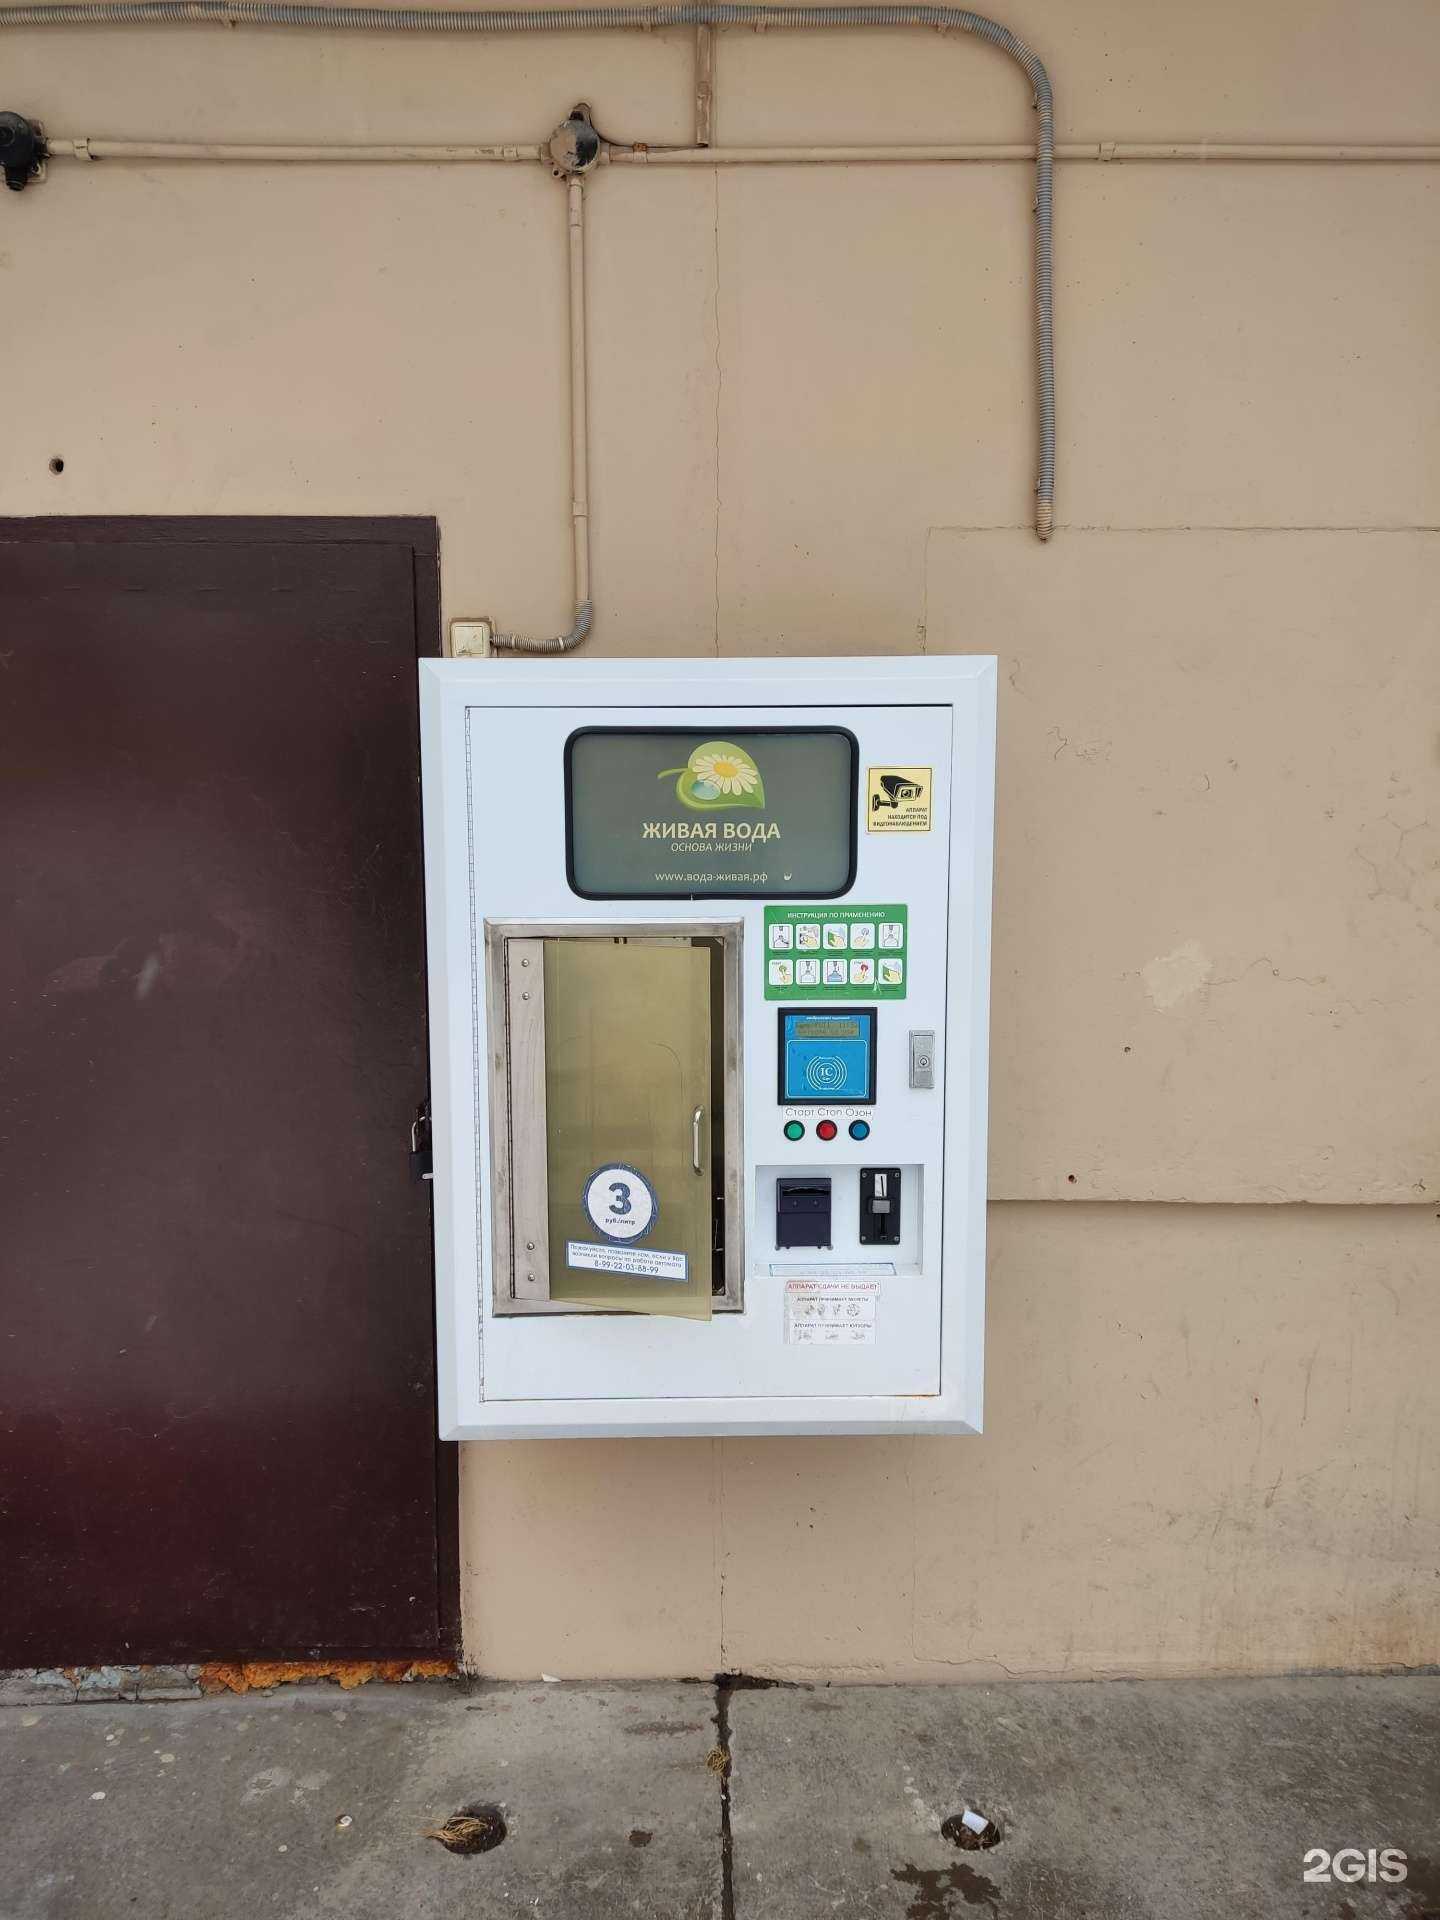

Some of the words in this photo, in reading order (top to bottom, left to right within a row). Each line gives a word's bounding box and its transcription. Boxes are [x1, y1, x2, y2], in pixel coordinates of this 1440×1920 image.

[642, 822, 717, 839] ЖИВАЯ
[723, 822, 781, 843] ВОДА
[671, 842, 713, 852] ОСНОВА
[715, 842, 752, 852] ЖИЗНИ
[655, 871, 768, 884] www.вода-живая.рф
[840, 911, 886, 919] ПРИМЕНЕНИЮ
[785, 1107, 815, 1117] Старт
[817, 1107, 843, 1117] Стоп
[845, 1107, 872, 1117] Озон
[608, 1182, 632, 1215] 3
